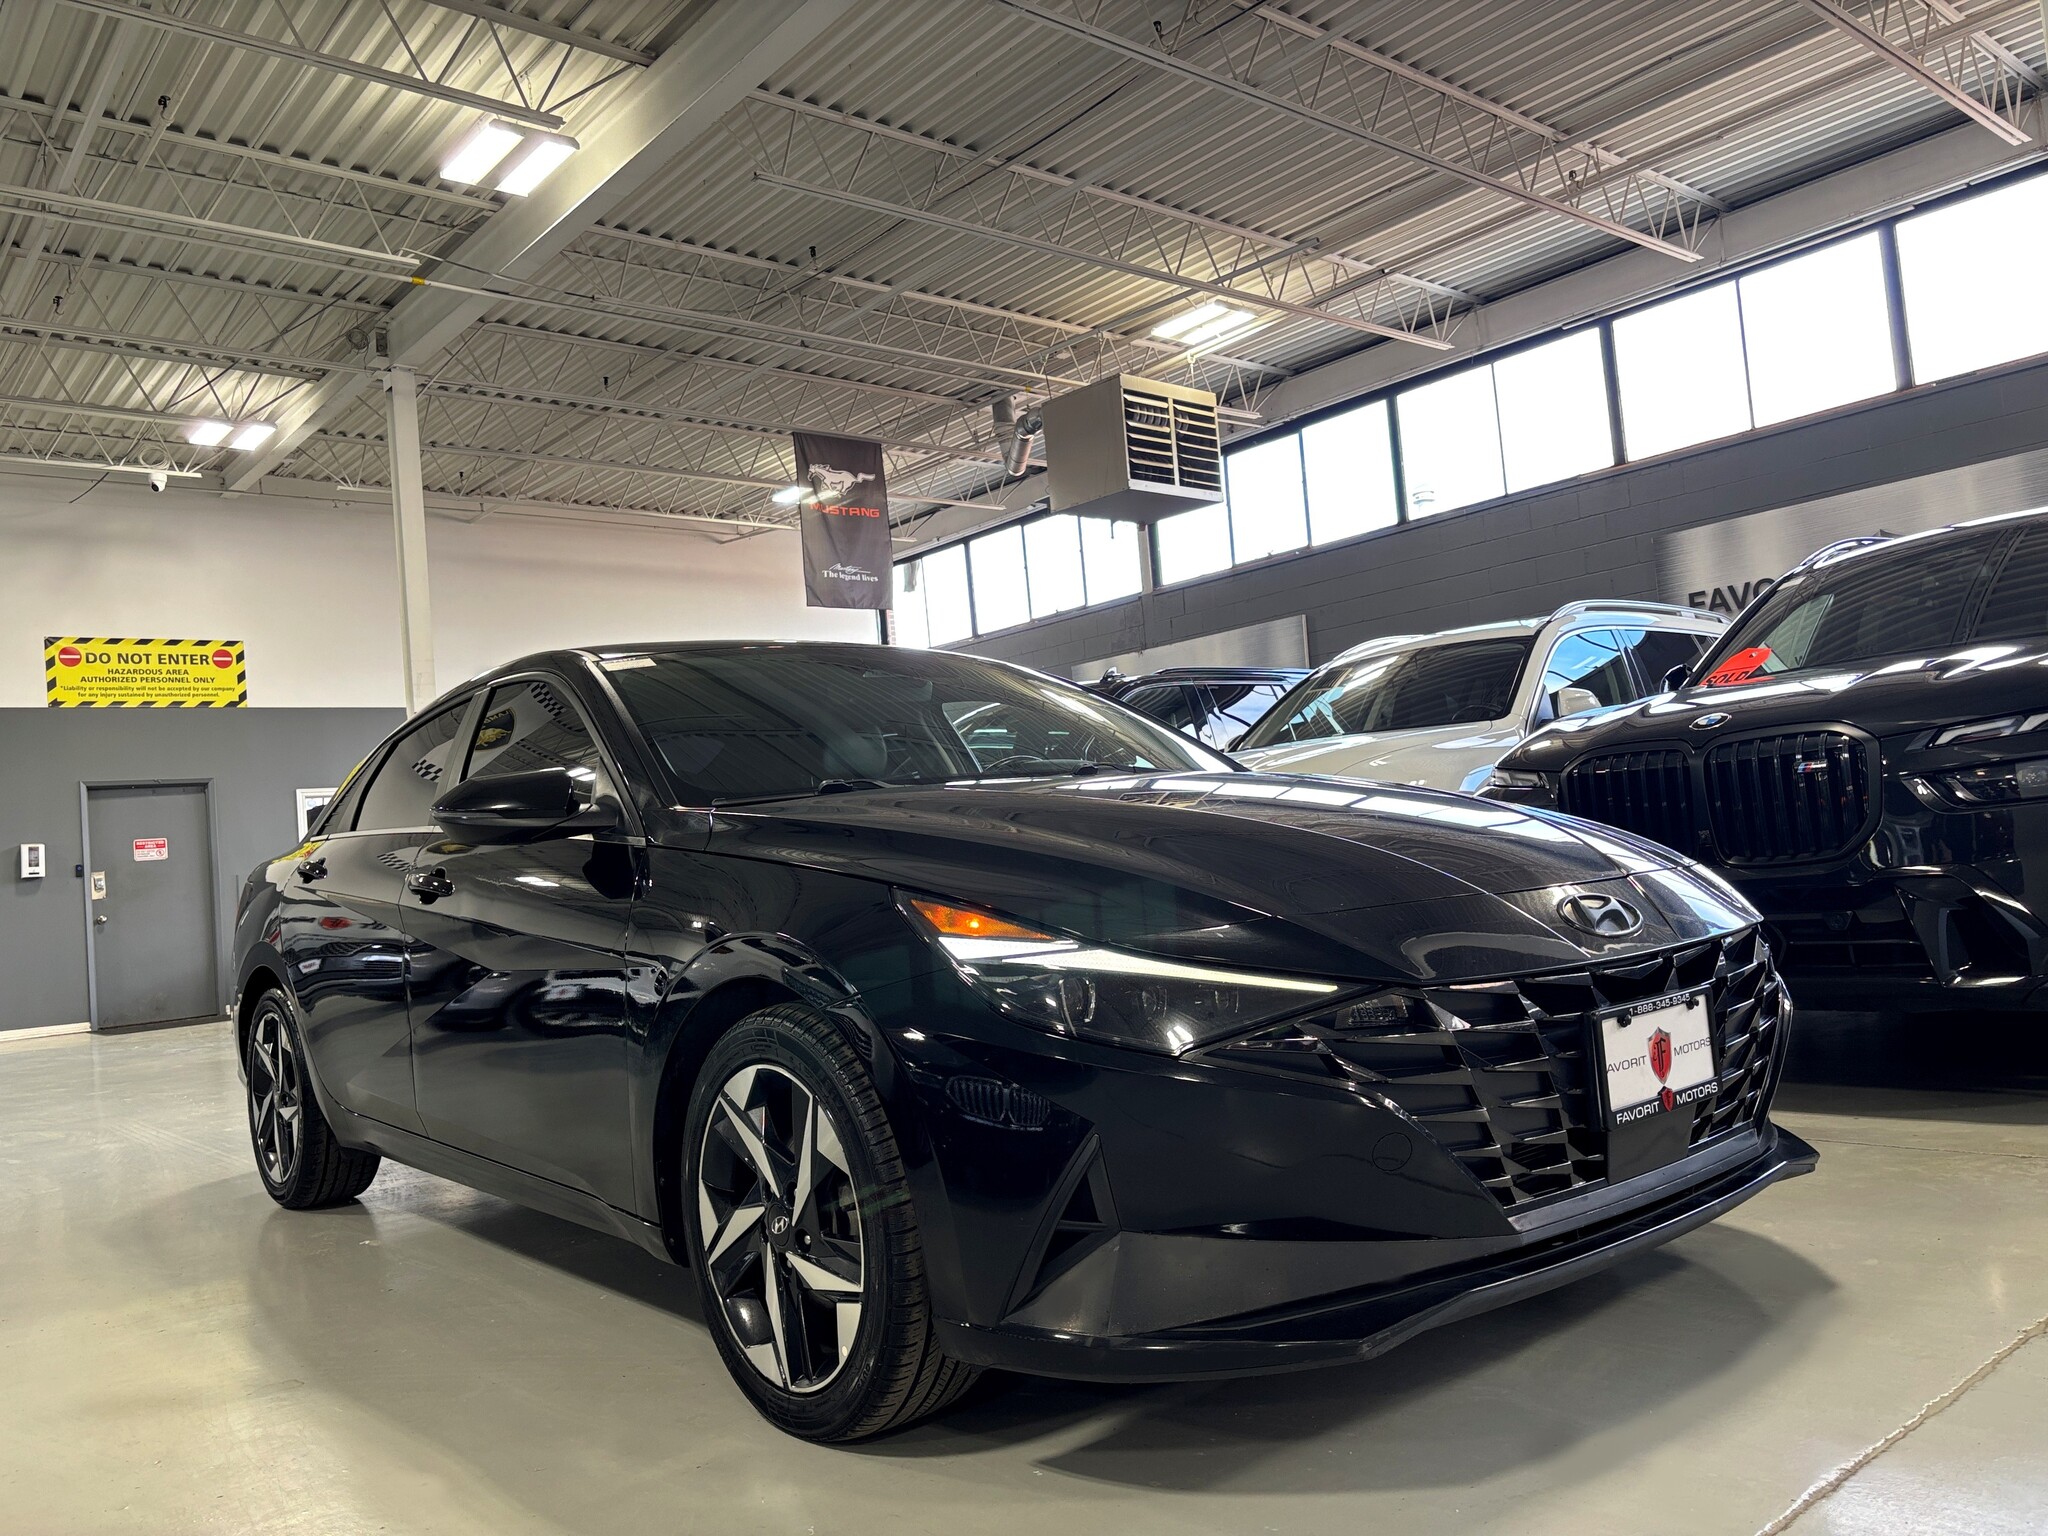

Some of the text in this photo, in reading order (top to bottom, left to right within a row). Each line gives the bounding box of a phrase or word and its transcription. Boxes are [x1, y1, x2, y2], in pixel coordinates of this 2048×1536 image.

[809, 502, 880, 518] MUSTANG
[822, 570, 879, 582] The legend lives
[85, 652, 210, 665] DO NOT ENTER
[1706, 670, 1750, 684] SOLD
[1629, 993, 1690, 1016] 1-888-345-9345
[1673, 1036, 1712, 1057] MOTORS
[1616, 1101, 1660, 1125] FAVORIT
[1676, 1081, 1718, 1105] MOTORS
